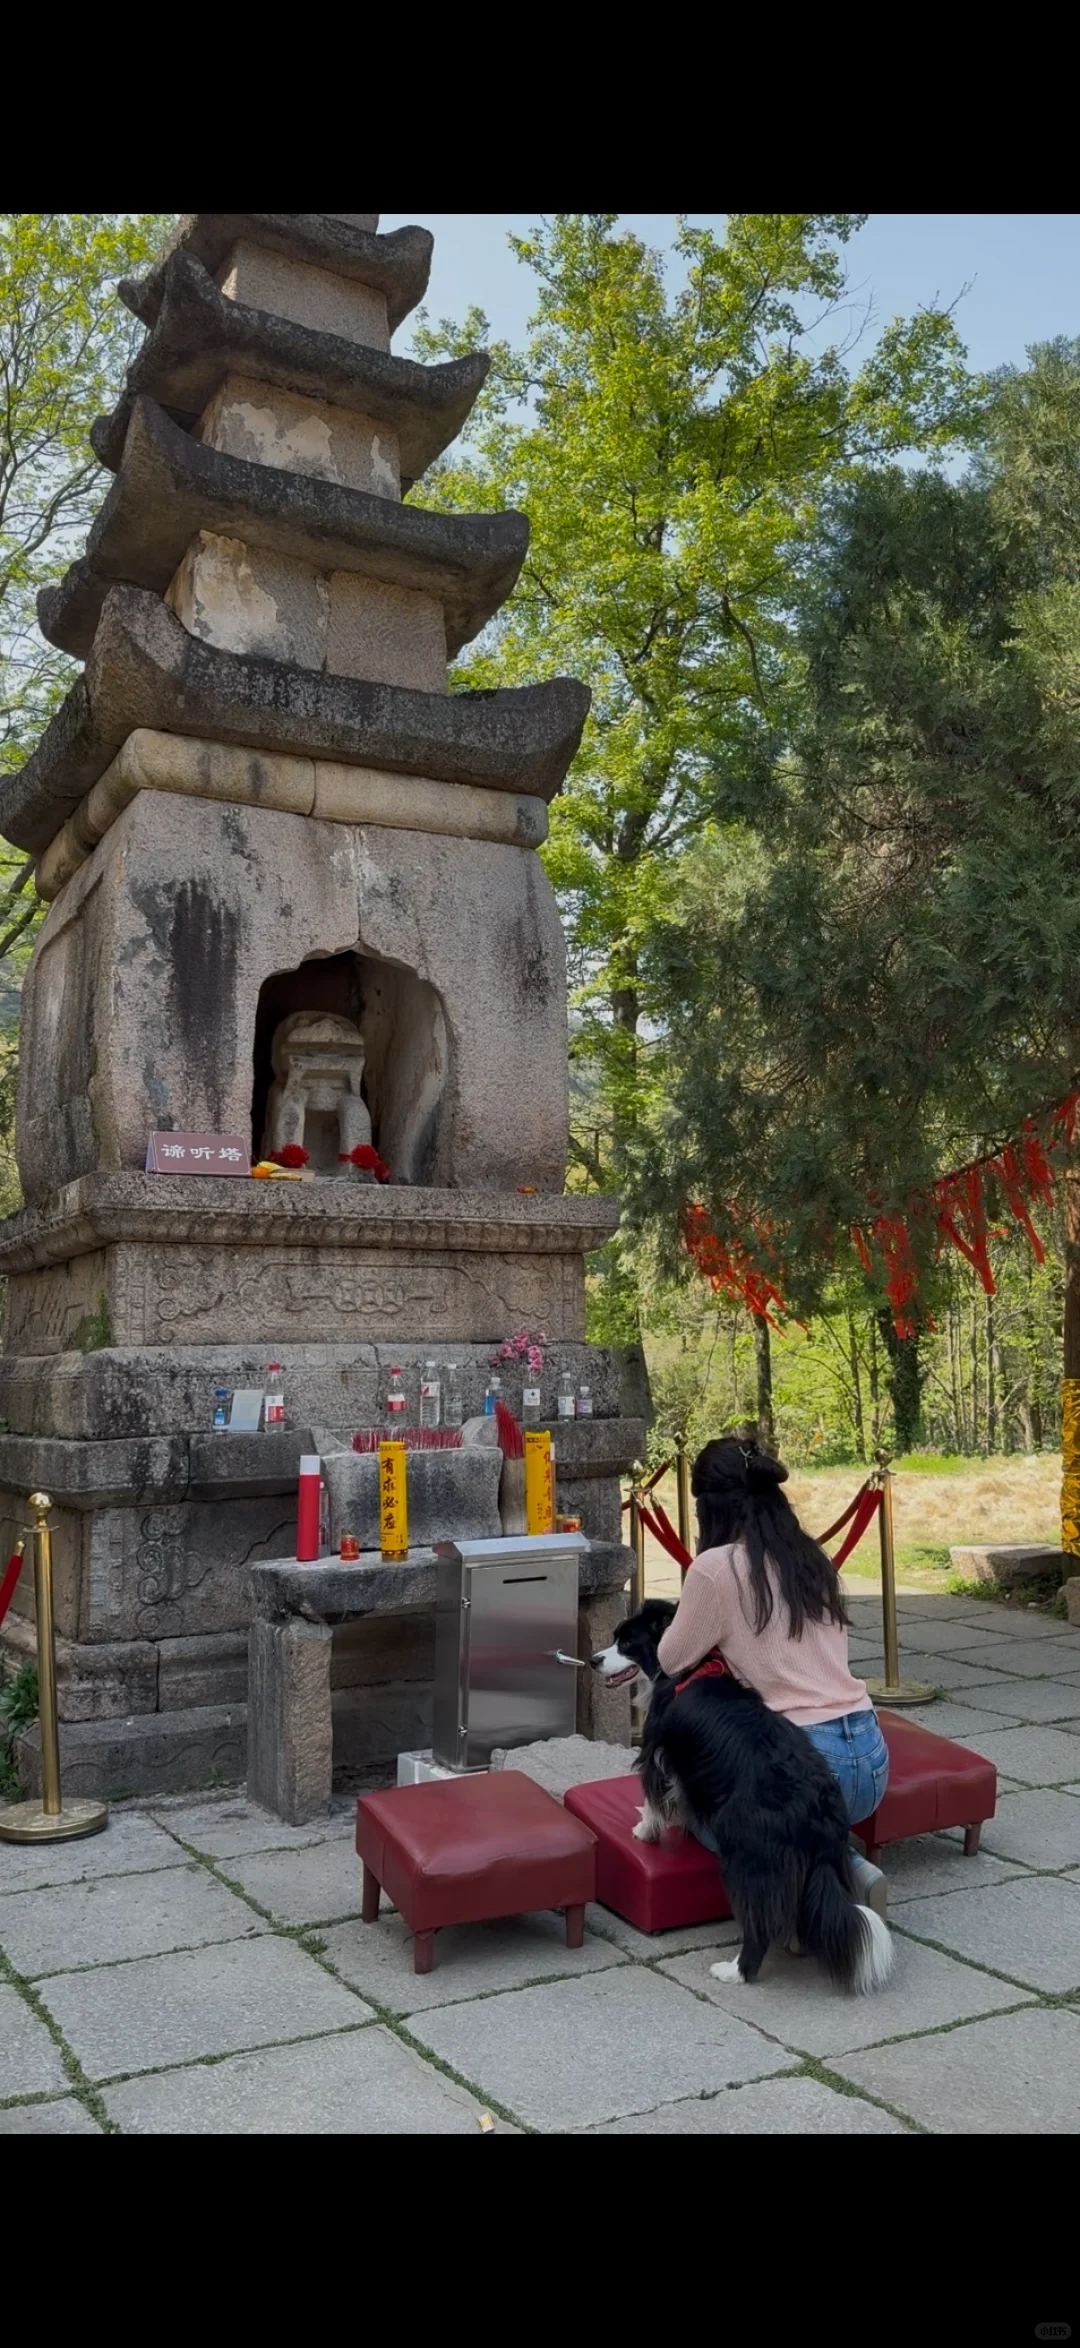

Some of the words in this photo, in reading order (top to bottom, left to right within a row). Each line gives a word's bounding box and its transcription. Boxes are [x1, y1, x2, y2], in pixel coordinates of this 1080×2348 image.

[161, 1144, 242, 1161] 谛听塔
[382, 1457, 399, 1530] 有求必应
